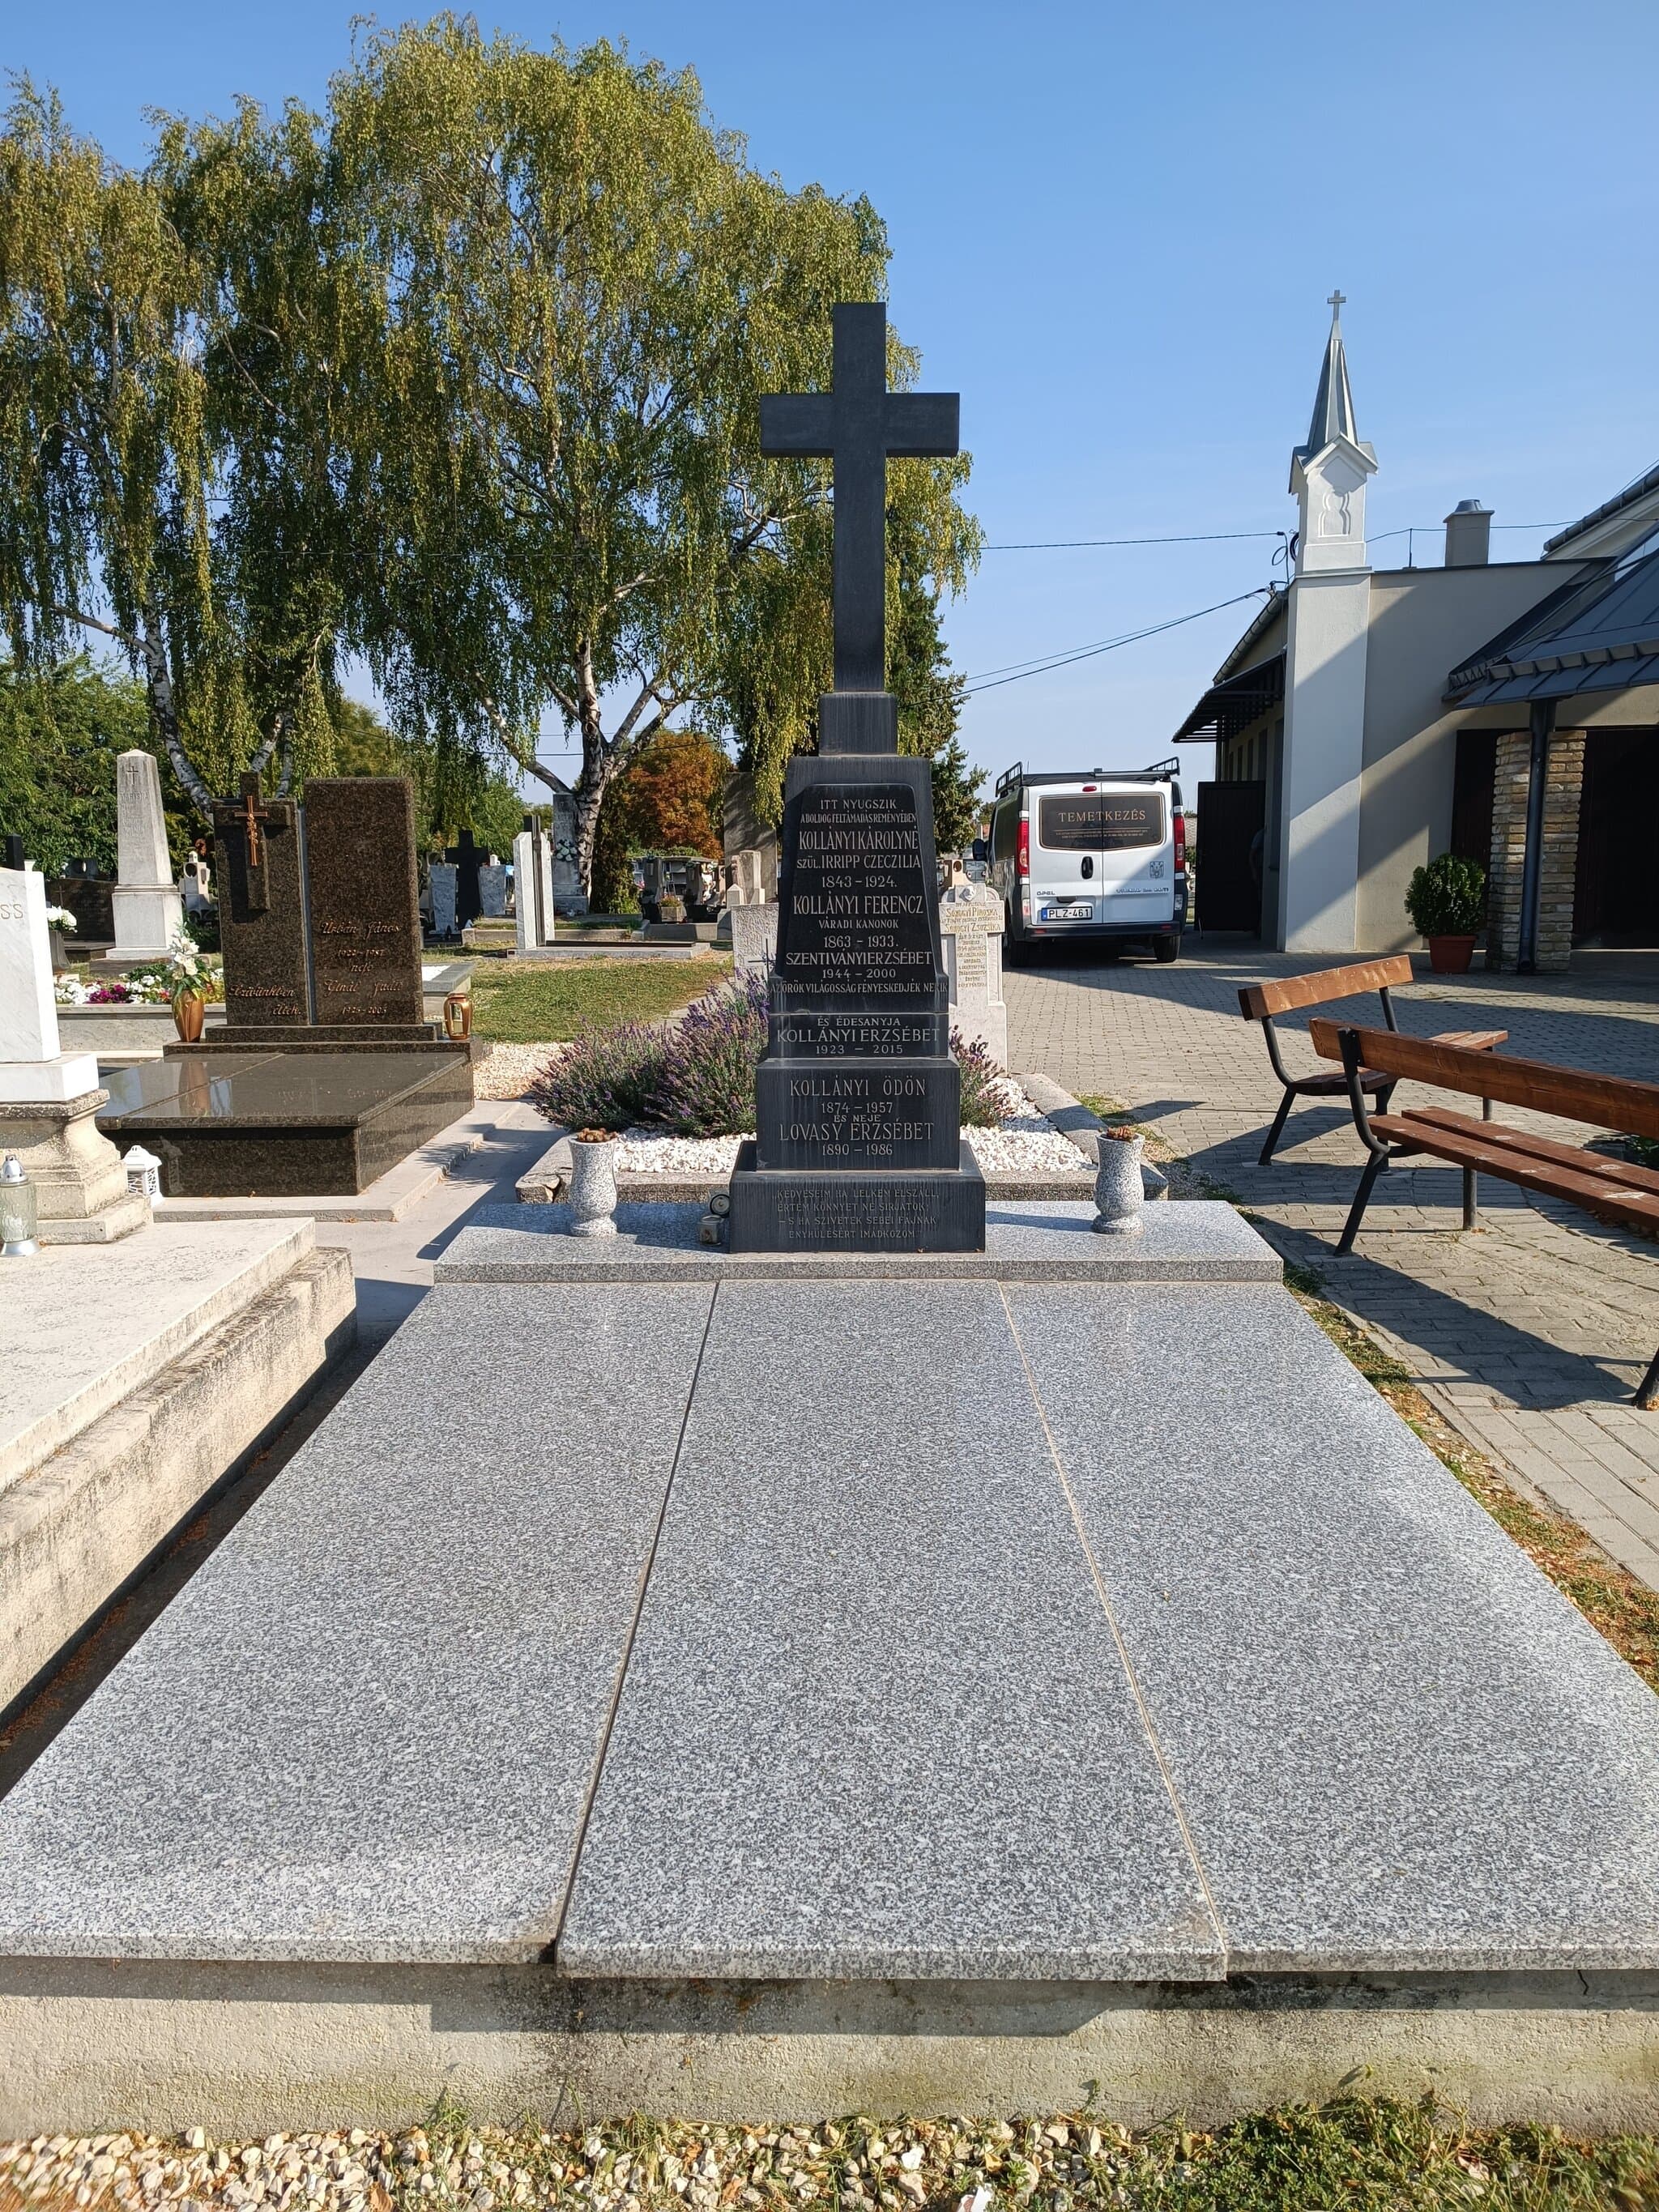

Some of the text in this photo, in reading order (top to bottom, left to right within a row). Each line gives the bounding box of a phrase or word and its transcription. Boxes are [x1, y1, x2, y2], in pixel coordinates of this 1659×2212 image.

[821, 799, 897, 809] ITT NYUGSZIK
[1058, 809, 1146, 822] TEMETKEZÉS
[800, 825, 919, 850] KOLLÁNYI KÁROLYNÉ
[864, 855, 921, 868] CZECZILIA
[821, 876, 851, 888] 1843
[793, 891, 923, 914] KOLLÁNYI FERENCZ
[1049, 909, 1089, 918] PLZ-461
[819, 917, 899, 929] VÁRADI KANONOK
[824, 936, 851, 948] 1863
[786, 948, 932, 965] SZENTIVÁNYI ERZSÉBET
[822, 969, 851, 978] 1944
[867, 969, 896, 978] 2000
[805, 978, 856, 993] VILÁGOSSÁG
[858, 978, 920, 992] FÉNYESKEDJÉK
[836, 1016, 901, 1026] ÉDESANYJA
[777, 1026, 940, 1042] KOLLÁNYI ERZSÉBET
[816, 1045, 844, 1054] 1923
[873, 1045, 903, 1054] 2015
[791, 1075, 926, 1096] KOLLÁNYI ÖDÖN
[821, 1102, 851, 1115] 1874
[866, 1102, 893, 1113] 1957
[853, 1115, 881, 1123] NEJE
[780, 1117, 935, 1140] LOVASY ERZSÉBET
[822, 1144, 850, 1155] 1890
[866, 1144, 893, 1155] 1986
